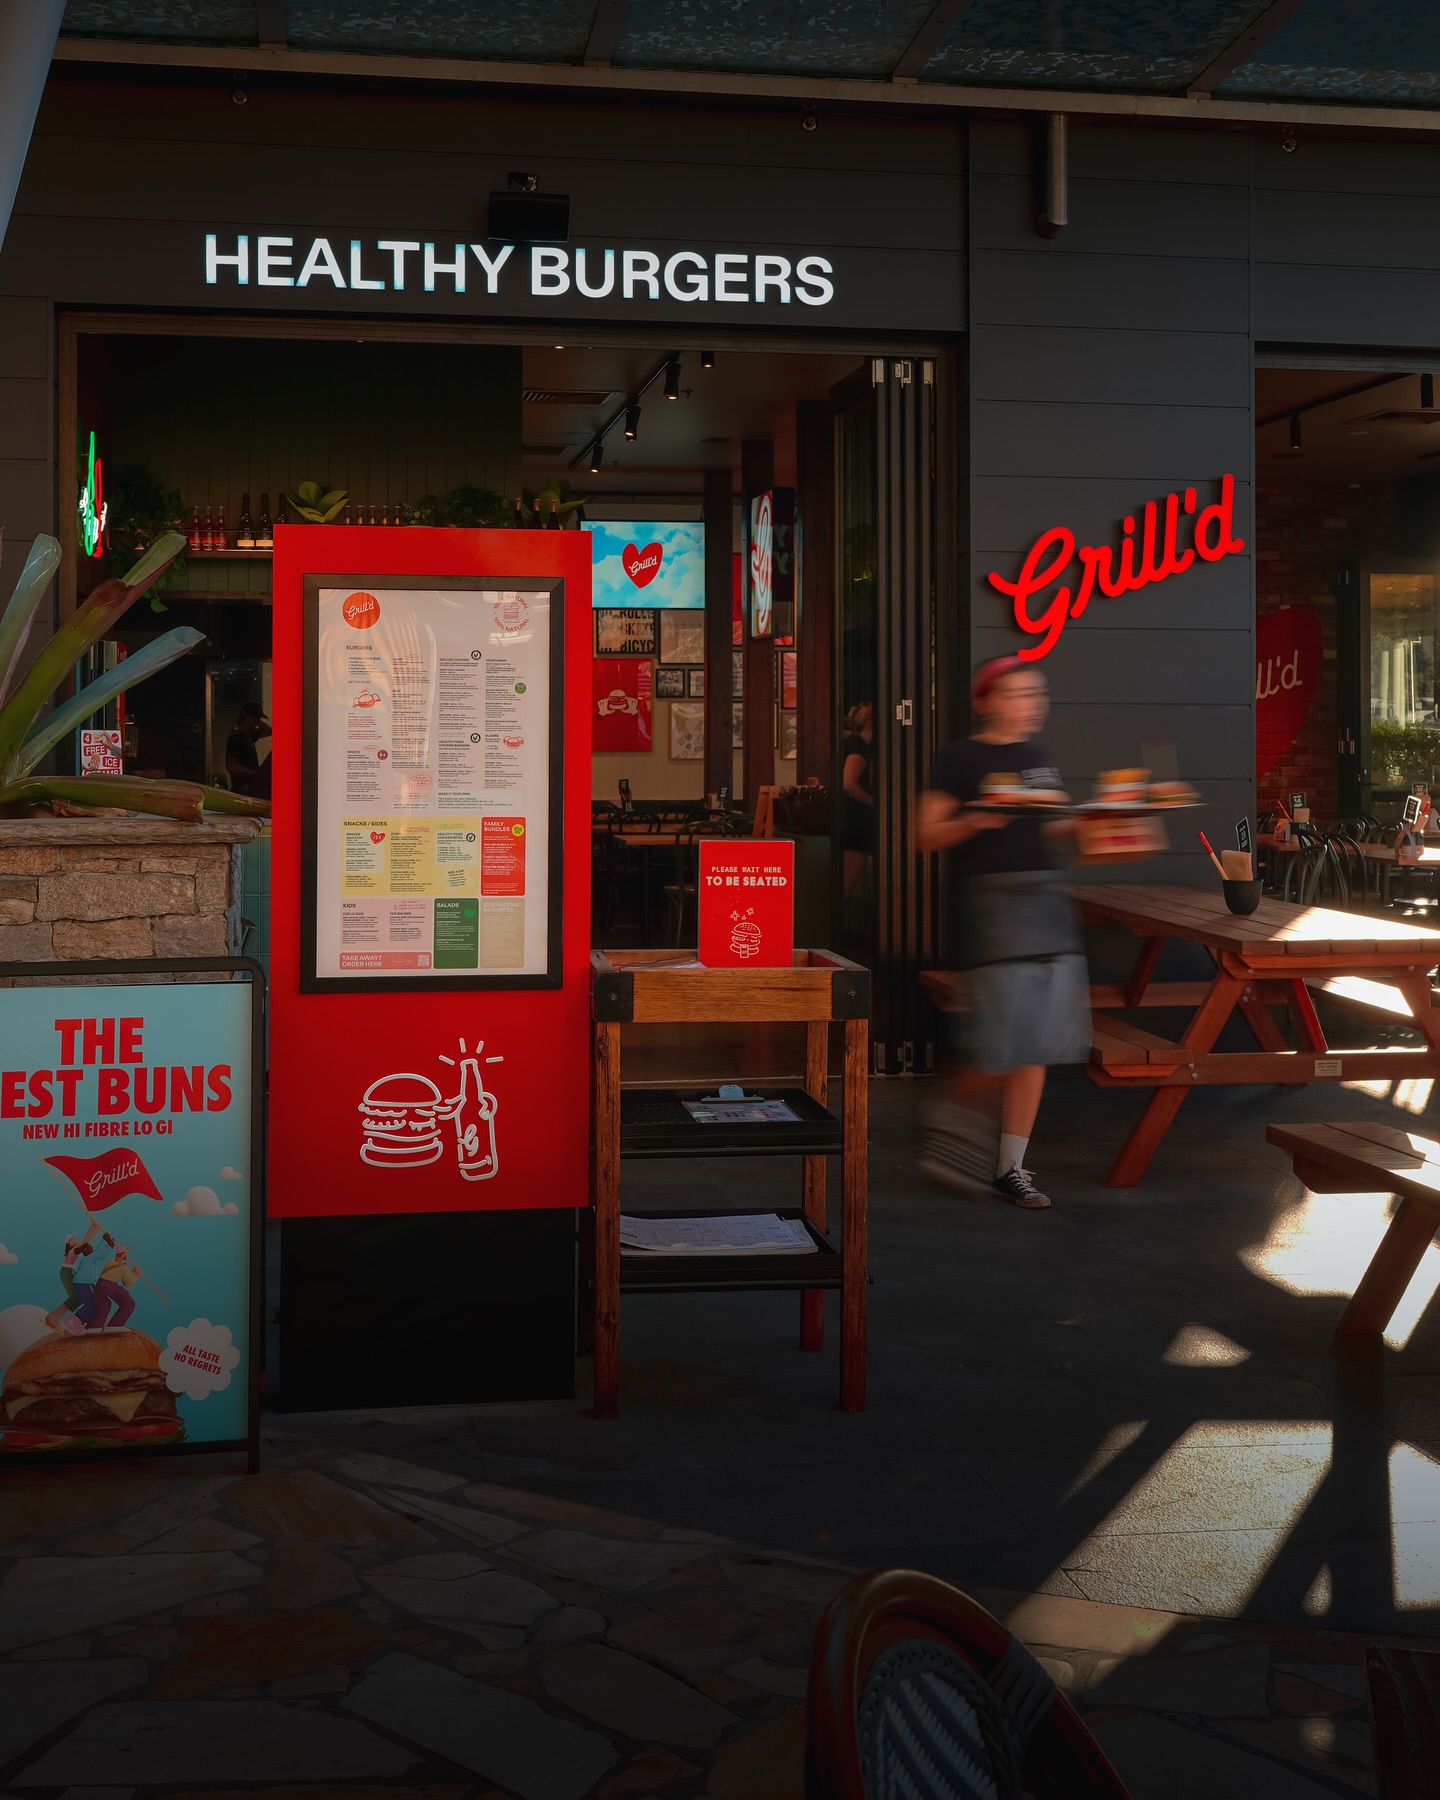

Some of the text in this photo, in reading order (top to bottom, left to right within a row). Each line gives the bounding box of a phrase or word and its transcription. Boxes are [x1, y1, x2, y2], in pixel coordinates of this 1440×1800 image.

[205, 234, 834, 306] HEALTHY BURGERS
[628, 555, 658, 577] Grill'd
[988, 473, 1245, 662] Grill'd
[345, 600, 376, 621] Grill'd
[505, 618, 530, 632] NATURAL
[85, 734, 91, 744] 4
[86, 746, 106, 755] FREE
[105, 758, 118, 767] ICE
[706, 876, 787, 887] TO BE SEATED
[55, 1017, 144, 1065] THE
[97, 1064, 232, 1115] BUNS
[23, 1120, 173, 1139] NEW HI FIBRE LO GI
[84, 1158, 139, 1198] Grill'd
[174, 1352, 222, 1375] NO REGRETS
[182, 1344, 221, 1364] ALL TASTE
